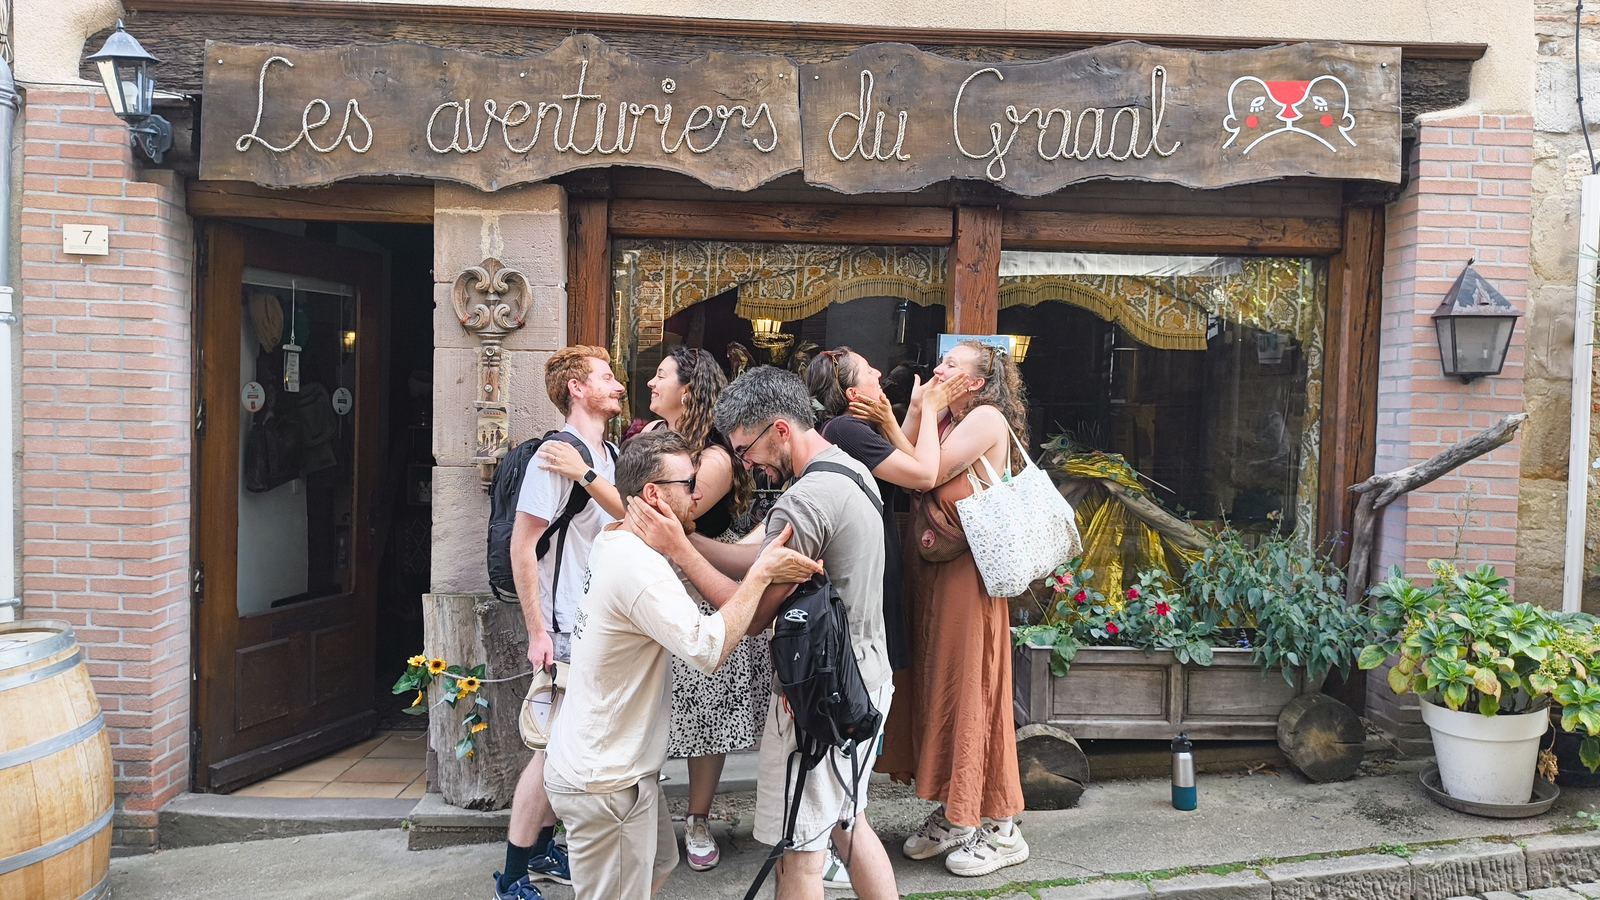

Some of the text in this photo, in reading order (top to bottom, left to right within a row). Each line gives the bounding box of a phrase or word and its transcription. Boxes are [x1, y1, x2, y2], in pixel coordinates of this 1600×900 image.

[236, 56, 373, 153] Les
[427, 61, 778, 154] aventuriers
[829, 69, 910, 161] du
[82, 230, 93, 245] 7
